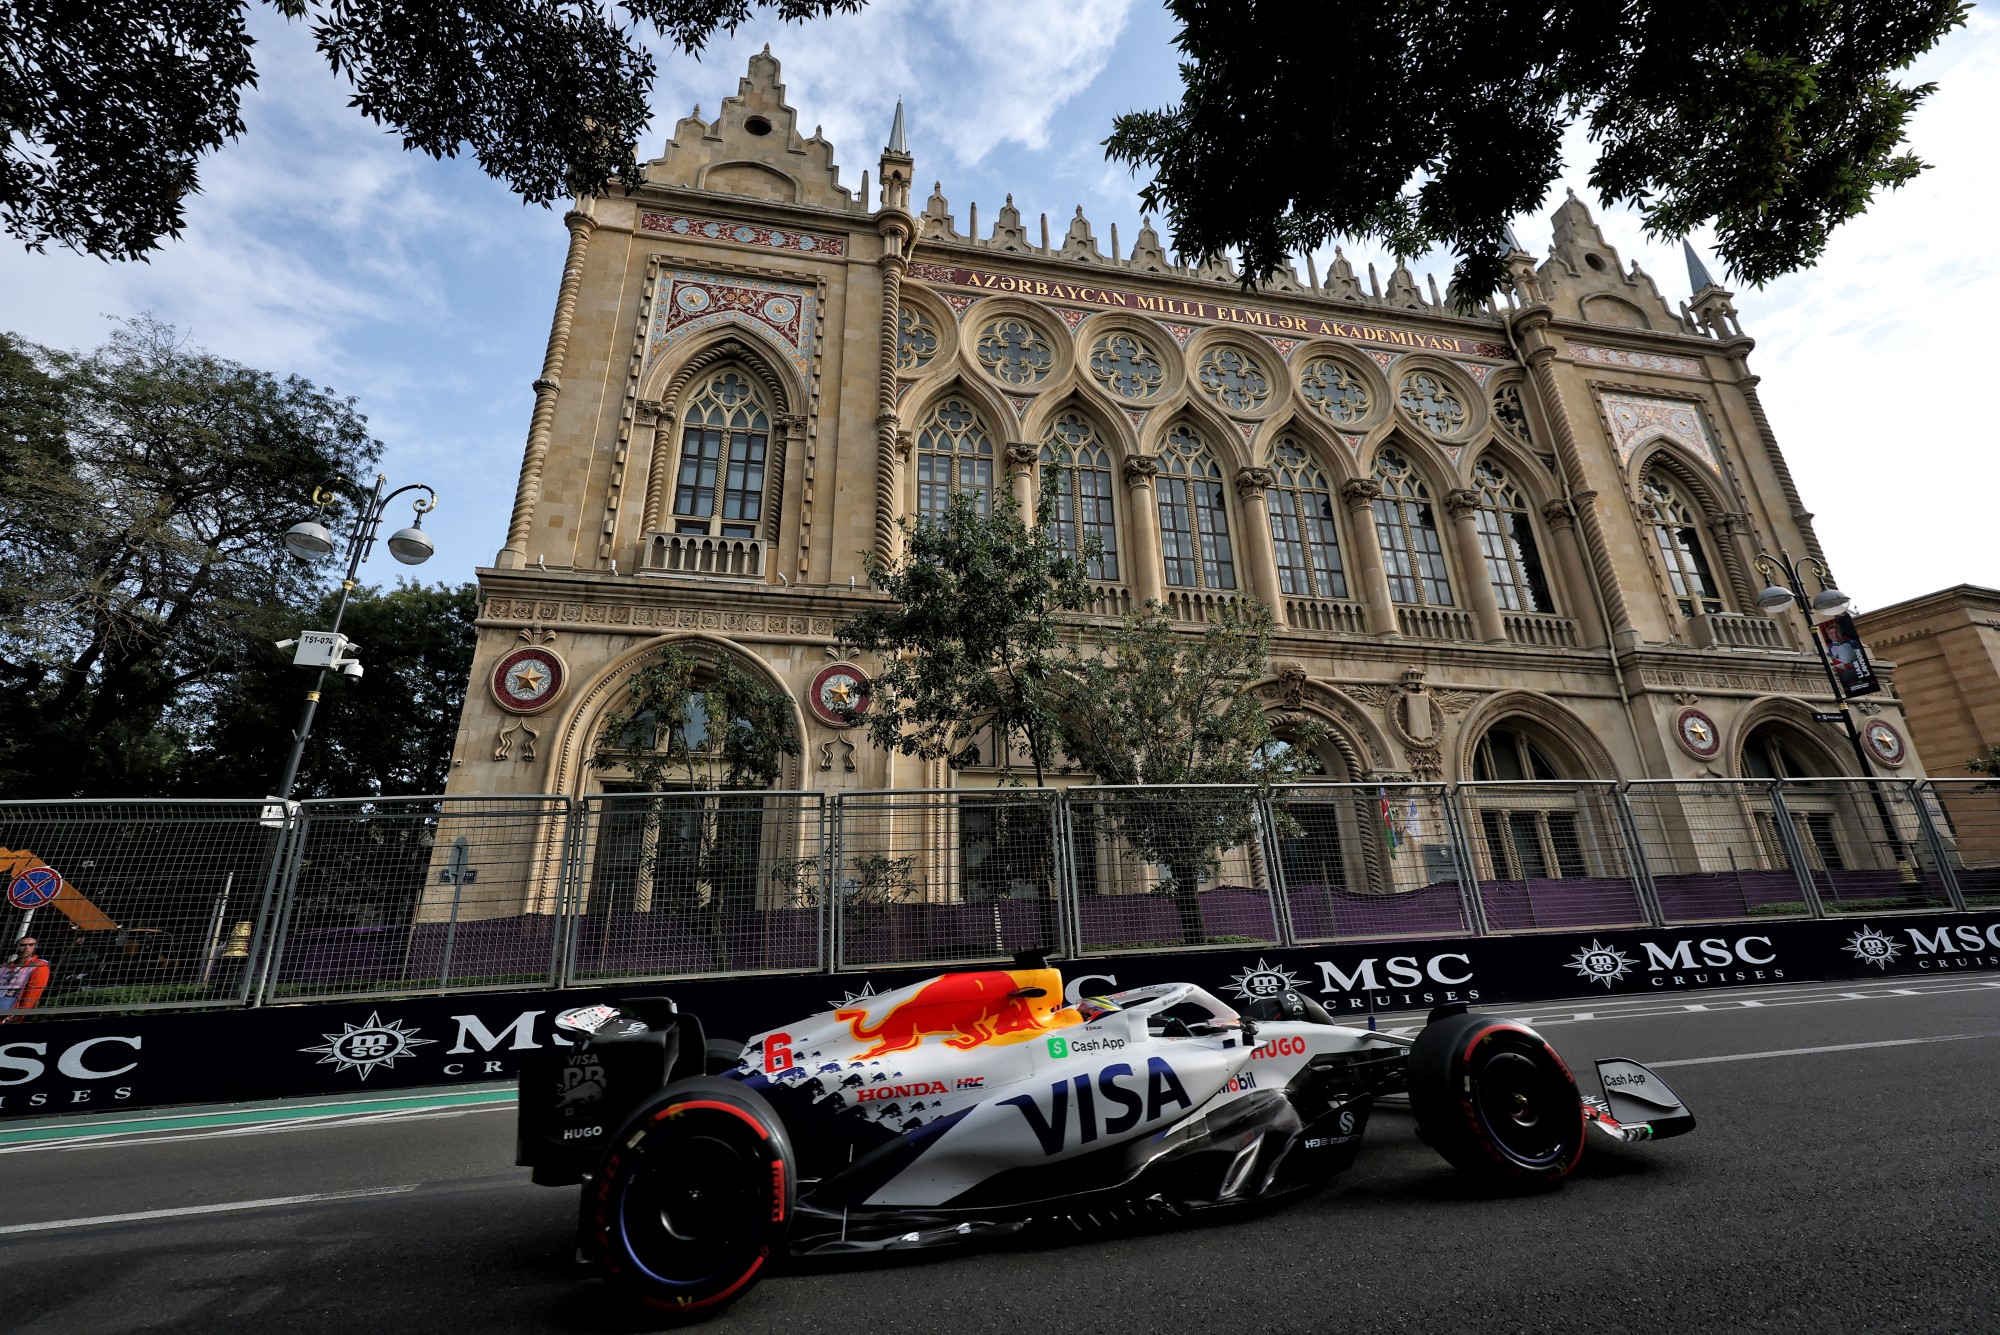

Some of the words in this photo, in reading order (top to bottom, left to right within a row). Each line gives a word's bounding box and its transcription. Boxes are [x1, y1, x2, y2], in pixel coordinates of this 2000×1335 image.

[966, 272, 1126, 306] AZƏRBAYCAN
[1136, 295, 1205, 317] MİLLİ
[1216, 307, 1309, 332] ELMLƏR
[1319, 322, 1461, 352] AKADEMİYASI
[1639, 936, 1777, 972] MSC
[1919, 956, 1998, 969] CRUIS
[1313, 953, 1474, 993] MSC
[1651, 968, 1785, 986] CRUISES
[1322, 989, 1480, 1010] CRUISES
[763, 1032, 794, 1073] 6
[1071, 1039, 1100, 1053] Cash
[1102, 1037, 1125, 1051] App
[0, 1035, 142, 1086] SC
[566, 1053, 600, 1066] VISA
[856, 1080, 949, 1103] HONDA
[956, 1076, 985, 1089] HRC
[1603, 1074, 1628, 1087] Cash
[1628, 1073, 1646, 1086] App
[994, 1055, 1193, 1157] VISA
[563, 1126, 603, 1139] HUGO
